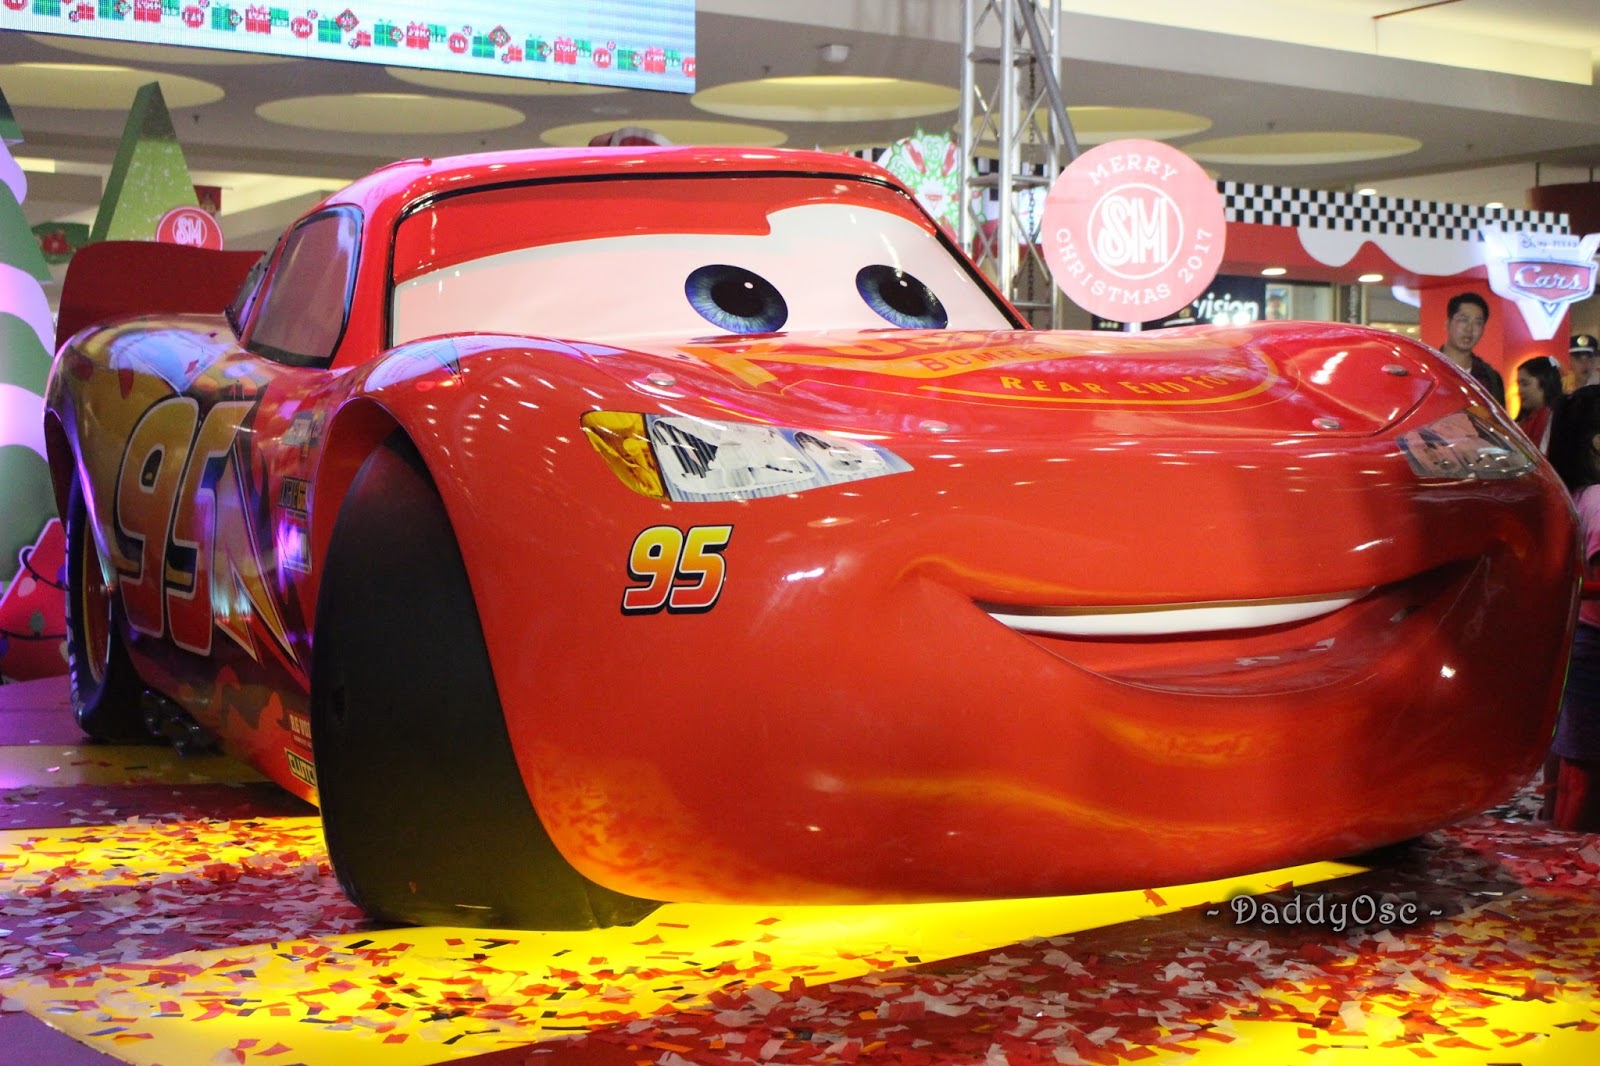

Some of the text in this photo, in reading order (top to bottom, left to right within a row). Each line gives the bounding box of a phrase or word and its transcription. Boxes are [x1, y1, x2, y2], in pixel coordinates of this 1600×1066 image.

[1088, 153, 1179, 185] MERRY
[175, 215, 202, 247] SM
[1097, 194, 1168, 266] SM
[1056, 228, 1213, 305] CHRISTMAS 2017
[1514, 264, 1583, 290] Cars
[999, 375, 1110, 393] REAR
[1117, 381, 1190, 394] END
[114, 395, 256, 657] 95
[621, 524, 734, 616] 95
